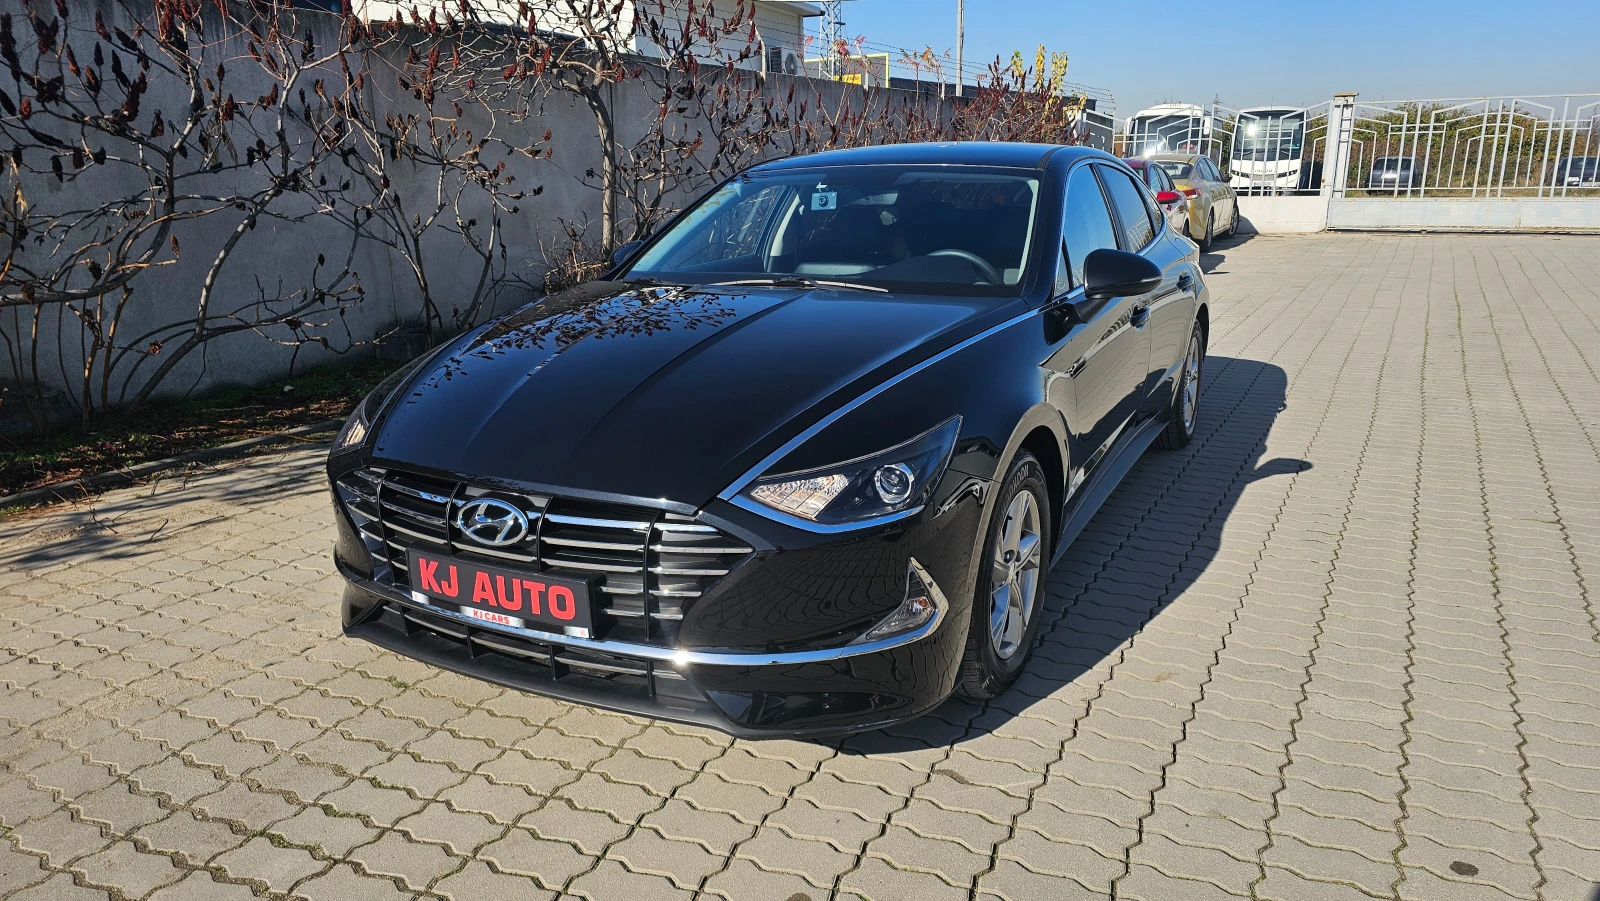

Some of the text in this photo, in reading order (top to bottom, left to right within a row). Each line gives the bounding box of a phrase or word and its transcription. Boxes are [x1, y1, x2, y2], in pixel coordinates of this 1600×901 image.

[419, 558, 576, 621] KJ AUTO
[473, 609, 510, 625] KJ CARS
